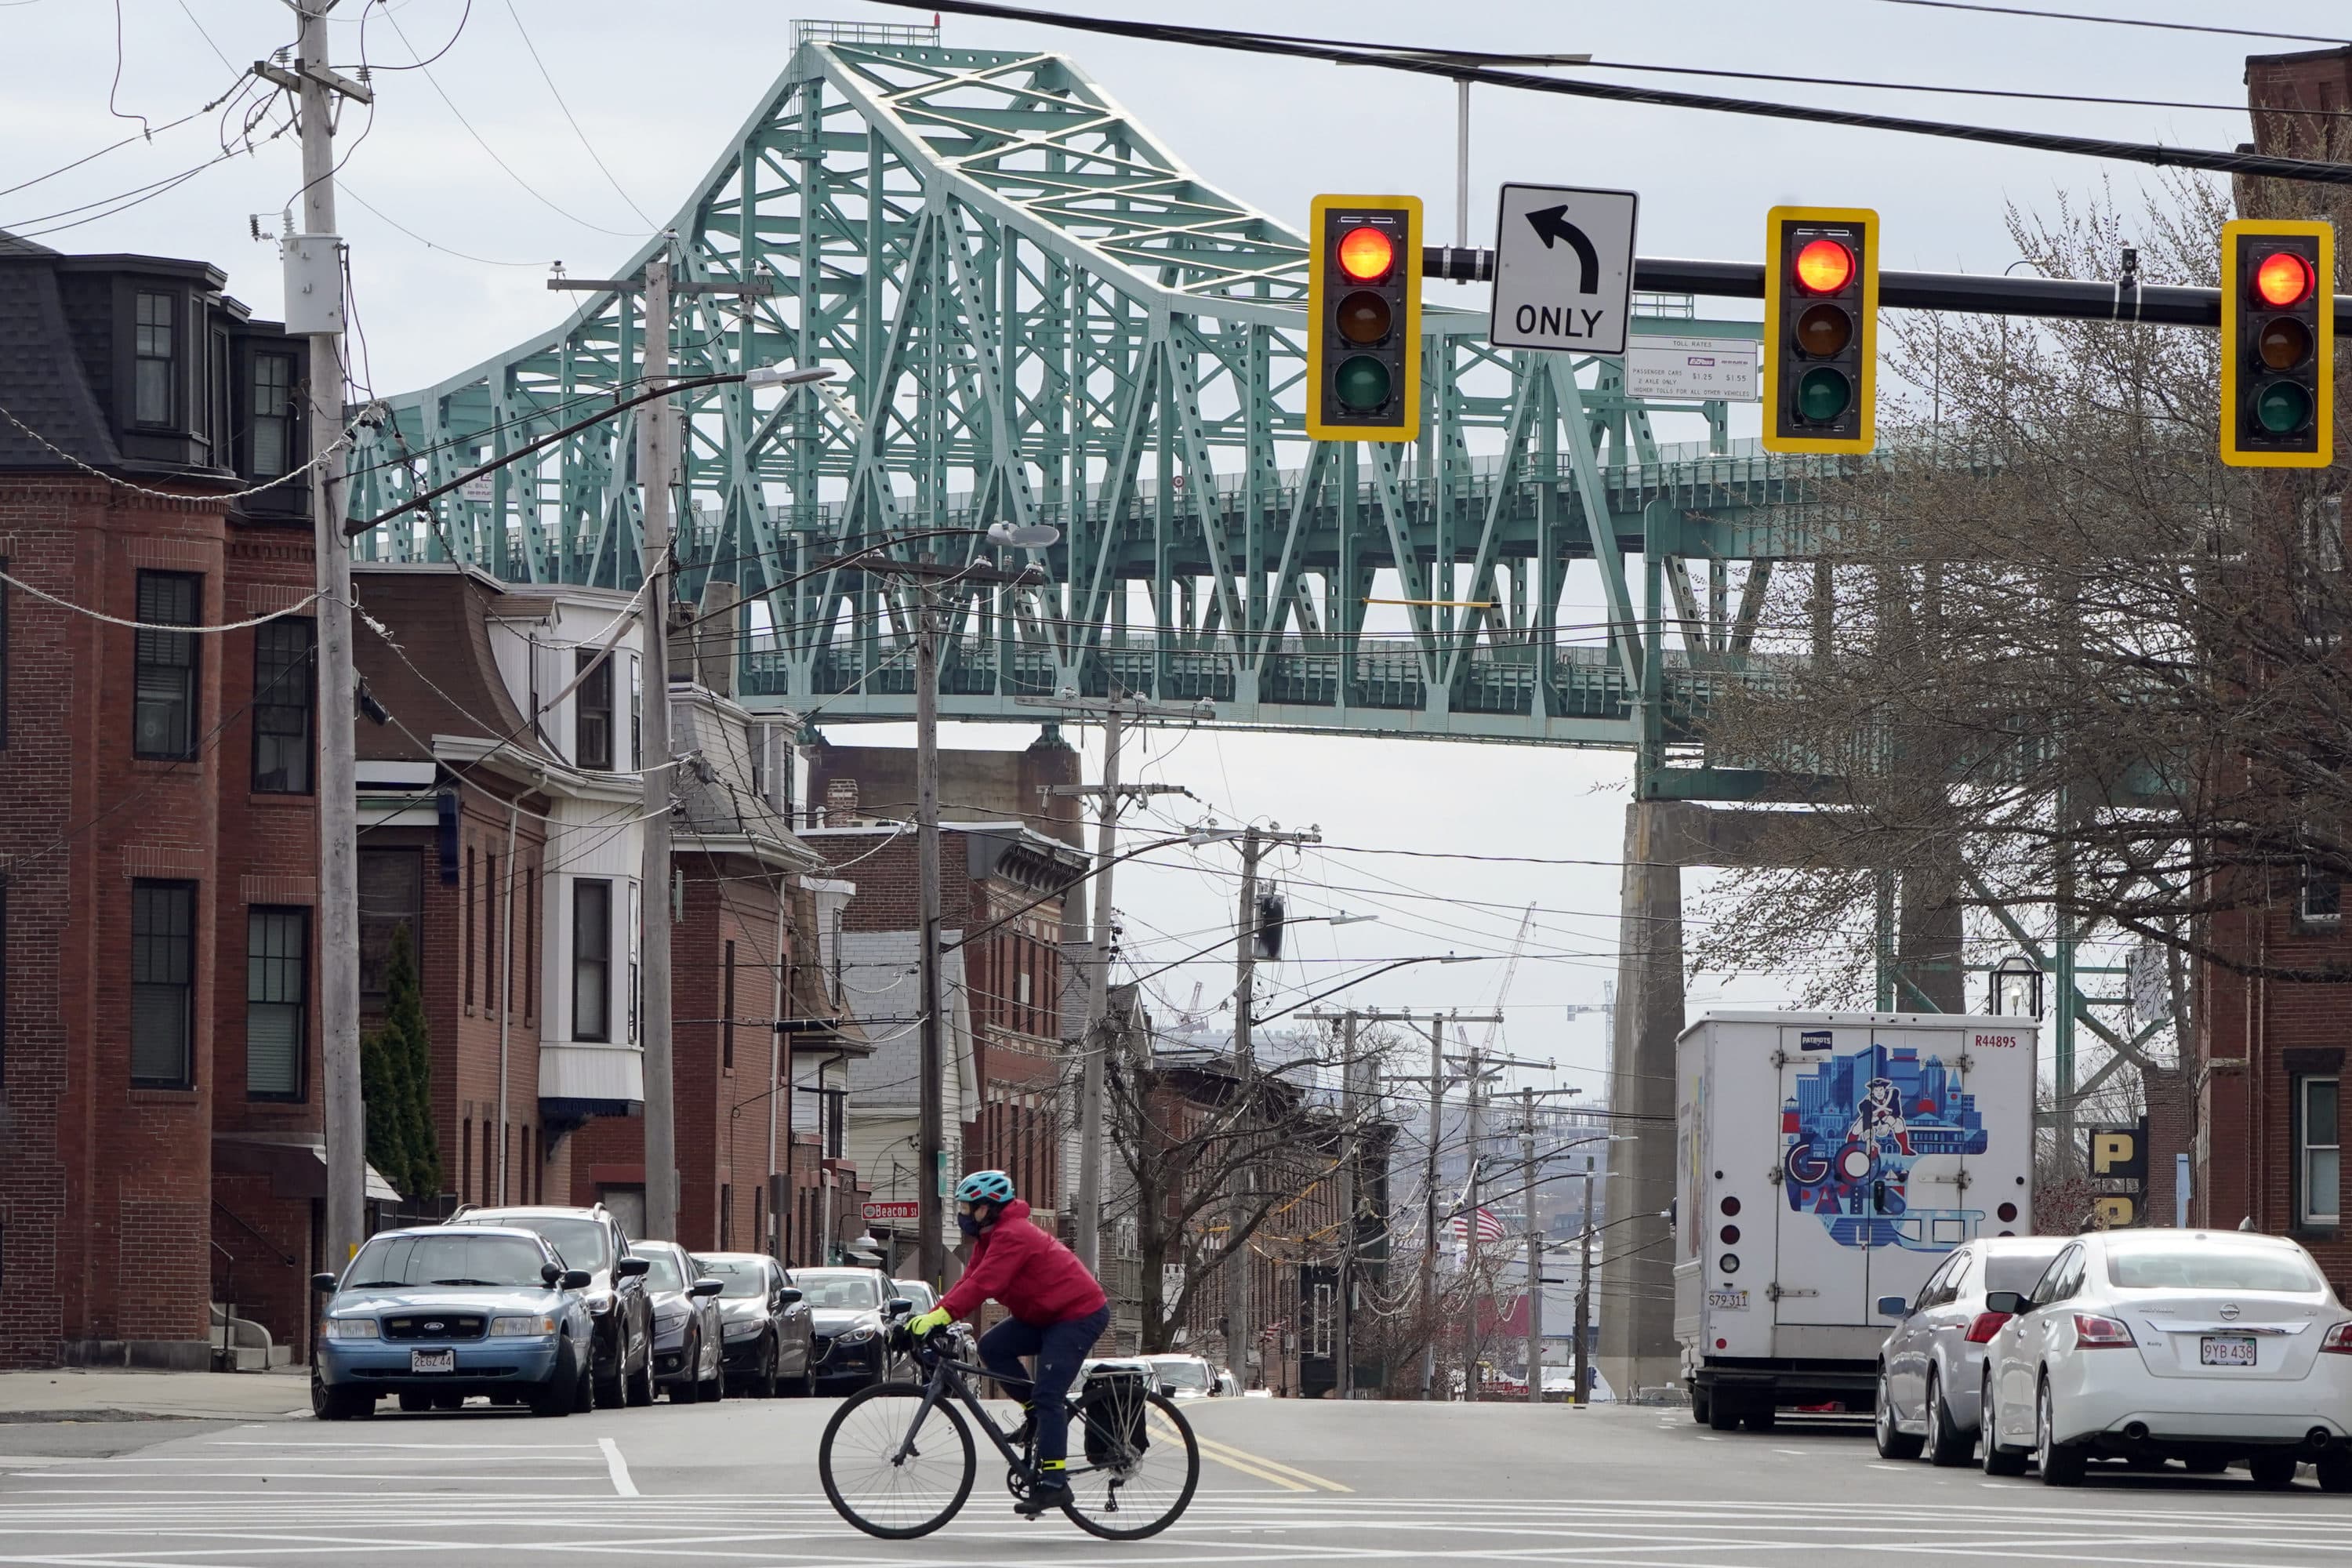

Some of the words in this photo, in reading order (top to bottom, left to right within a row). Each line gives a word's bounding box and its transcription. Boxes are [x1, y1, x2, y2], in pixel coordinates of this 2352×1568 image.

[1515, 304, 1604, 338] ONLY
[1802, 1036, 1831, 1045] PATRIOTS
[1976, 1035, 2016, 1047] R44895
[1784, 1141, 1882, 1187] GO
[875, 1204, 908, 1218] Beacon
[2205, 1345, 2227, 1359] 9YB
[2230, 1345, 2253, 1359] 438
